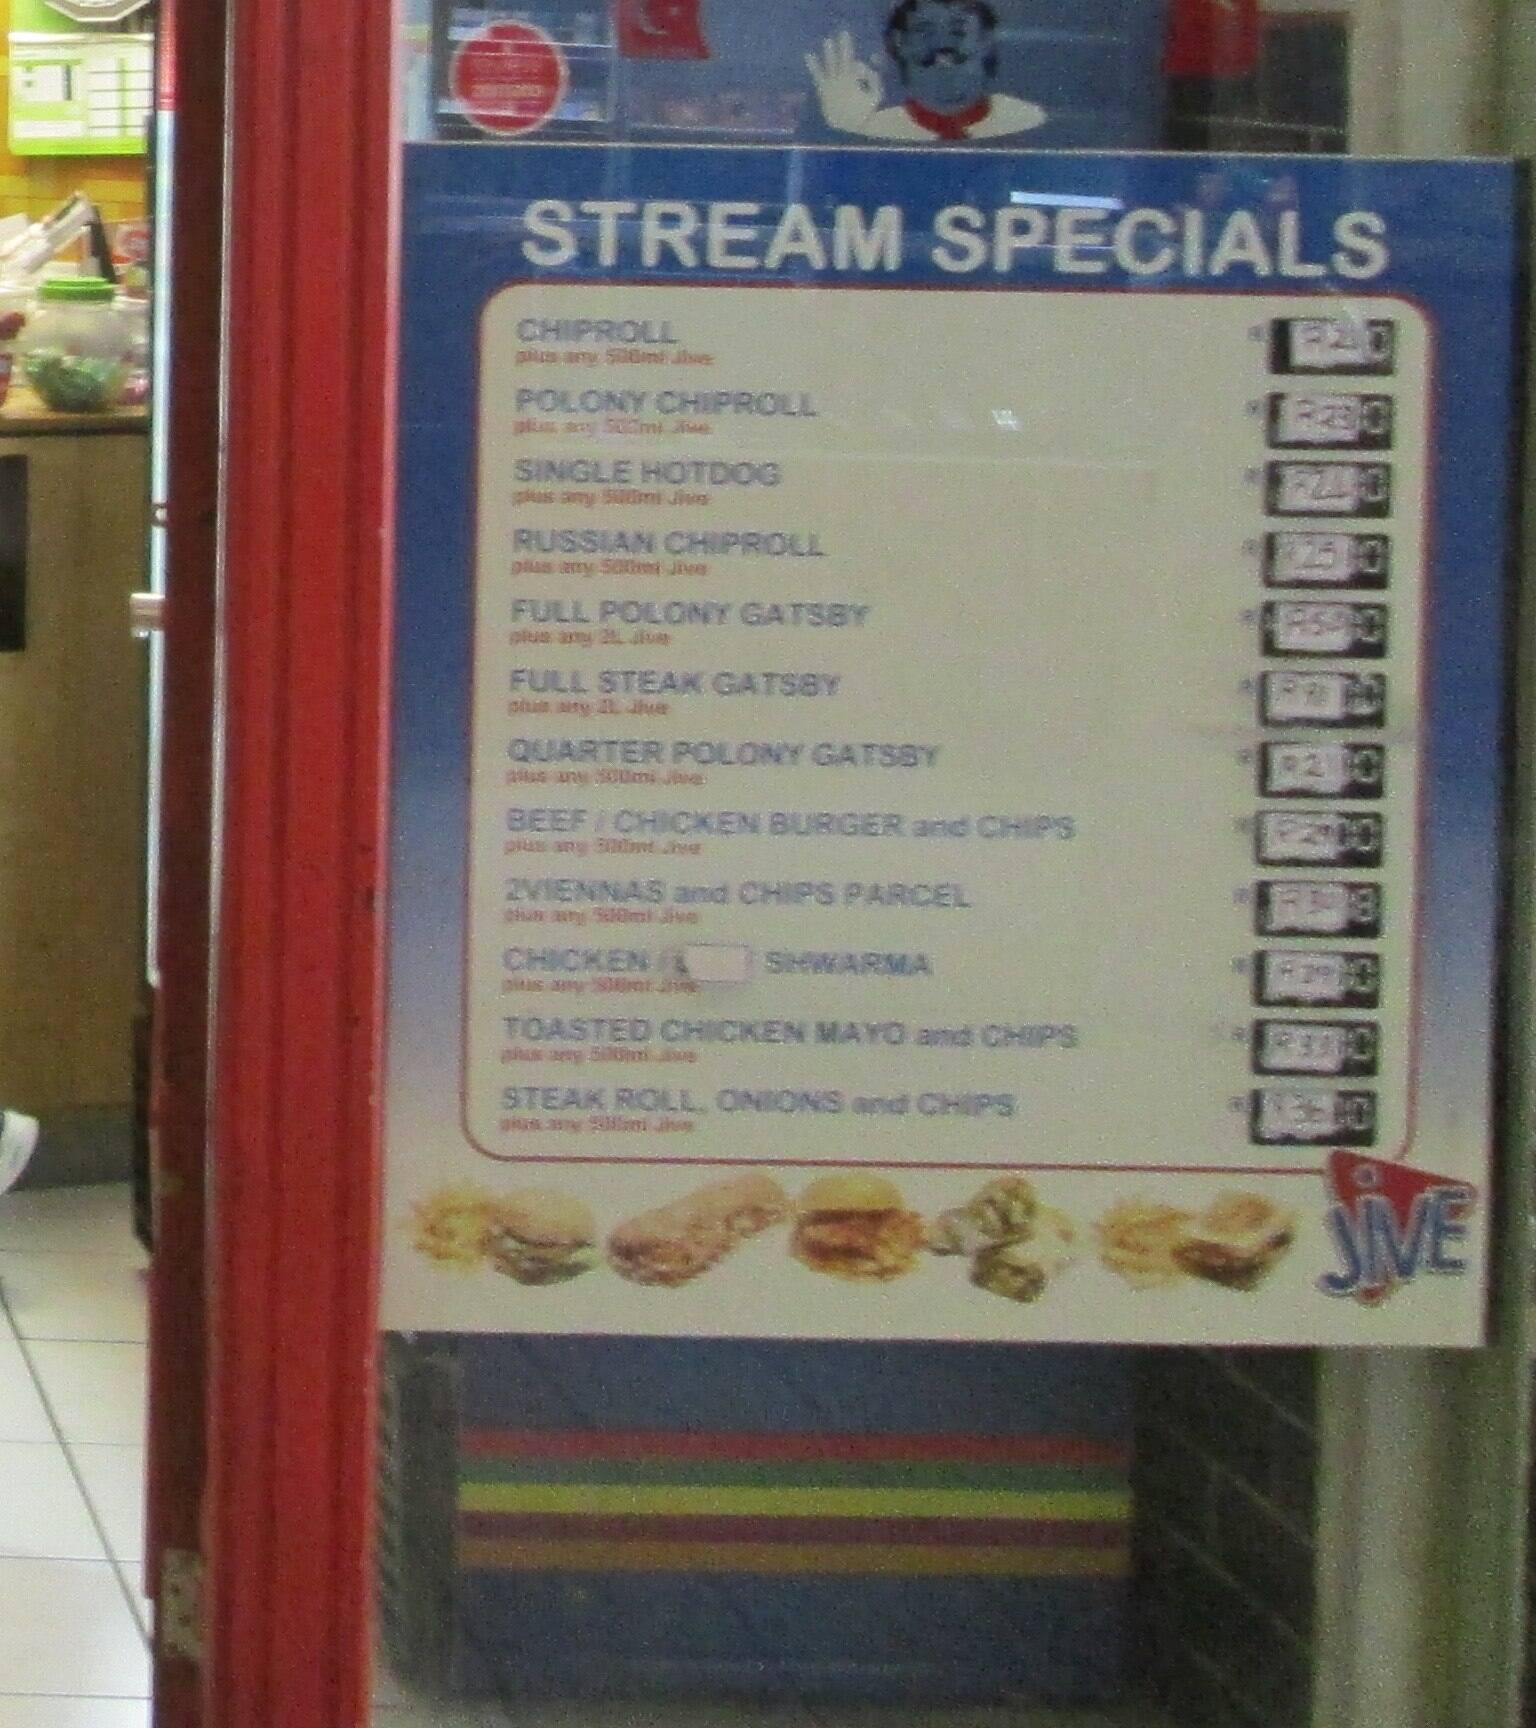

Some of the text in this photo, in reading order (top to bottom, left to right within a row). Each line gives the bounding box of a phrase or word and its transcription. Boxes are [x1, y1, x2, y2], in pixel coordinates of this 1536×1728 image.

[521, 199, 1392, 280] STREAM SPECIALS
[516, 319, 677, 344] CHIPROLL
[516, 389, 817, 417] POLONY CHIPROLL
[514, 459, 781, 486] SINGLE HOTDOG
[514, 529, 826, 557] RUSSIAN CHIPROLL
[511, 599, 870, 627] FULL POLONY GATSBY
[510, 669, 841, 697] FULL STEAK GATSBY
[509, 739, 938, 767] QUARTER POLONY GATSBY
[508, 809, 586, 833] BEEF
[614, 810, 759, 835] CHICKEN
[769, 813, 905, 837] BURGER
[913, 817, 966, 839] and
[977, 816, 1076, 840] CHIPS
[674, 883, 728, 906] and
[738, 882, 834, 906] CHIPS
[844, 883, 971, 908] PARCEL
[503, 948, 648, 972] CHICKEN
[765, 950, 934, 975] SHWARMA
[503, 1017, 1078, 1047] TOASTED CHICKEN MAYO and CHIPS
[503, 1087, 603, 1112] STEAK
[716, 1090, 841, 1113] ONIONS
[851, 1094, 910, 1115] and
[917, 1094, 1016, 1117] CHIPS
[1318, 1164, 1477, 1299] JIVE
